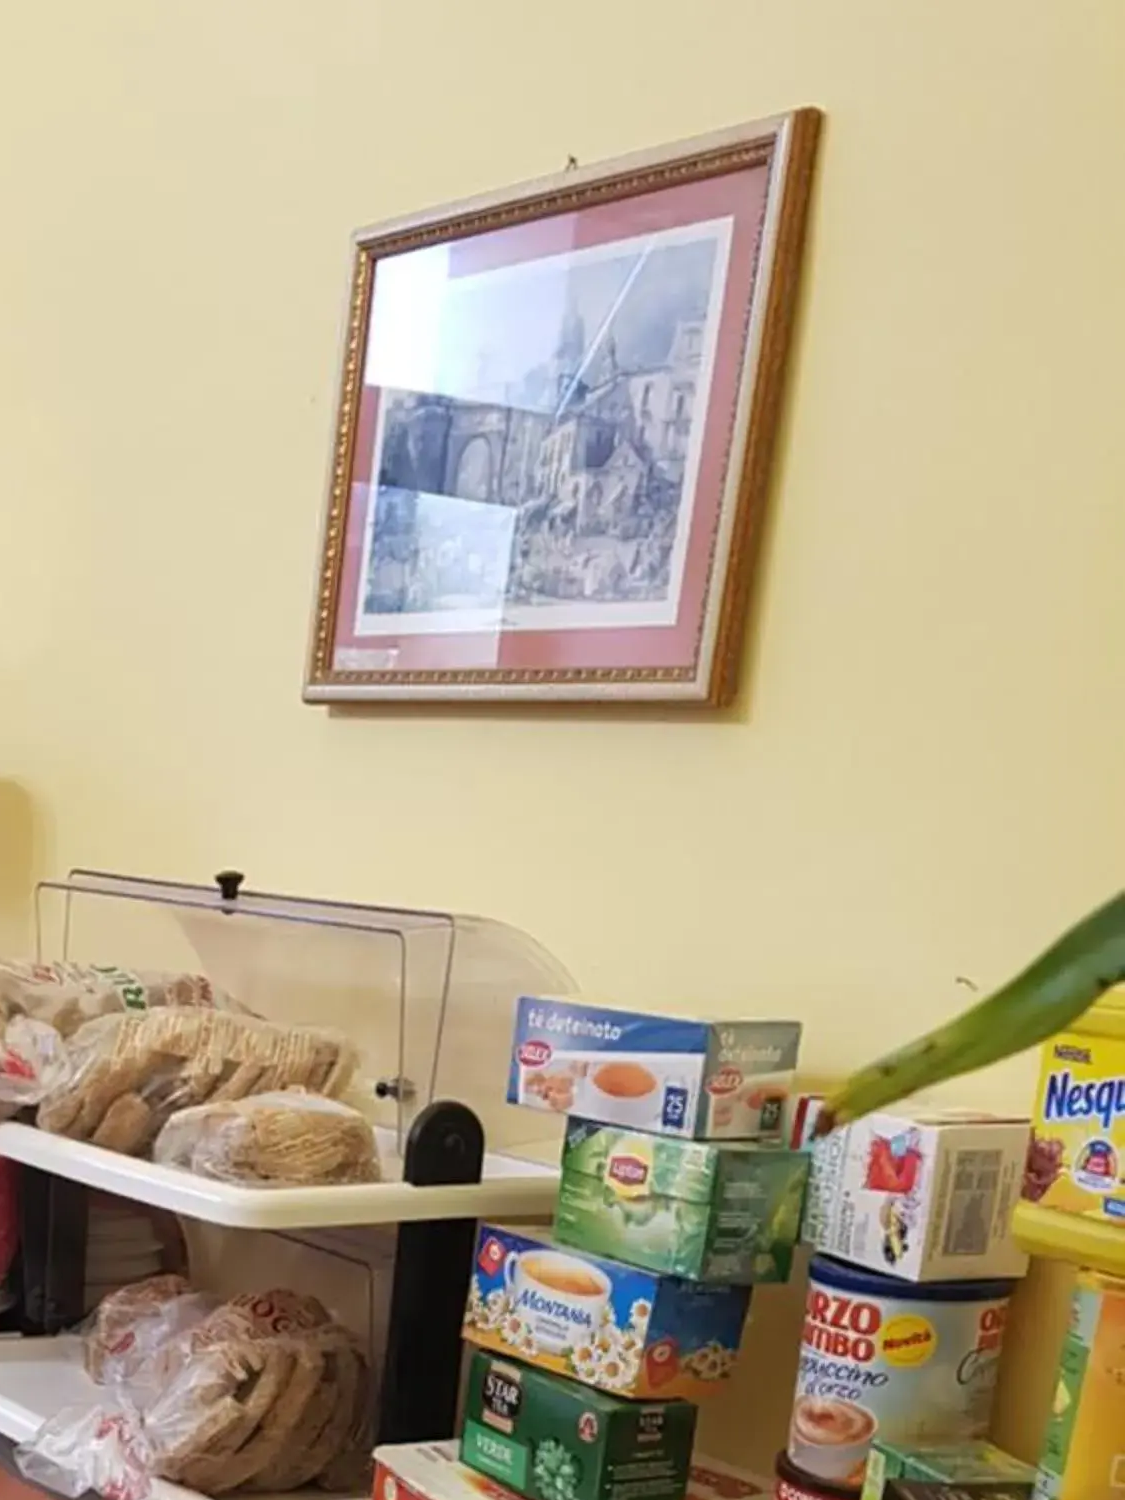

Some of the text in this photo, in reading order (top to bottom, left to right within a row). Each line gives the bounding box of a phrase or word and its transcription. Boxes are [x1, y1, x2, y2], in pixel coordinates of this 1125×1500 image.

[665, 1094, 684, 1114] 25
[807, 1289, 882, 1335] RZO
[486, 1374, 519, 1404] STAR
[476, 1432, 513, 1466] VERDE
